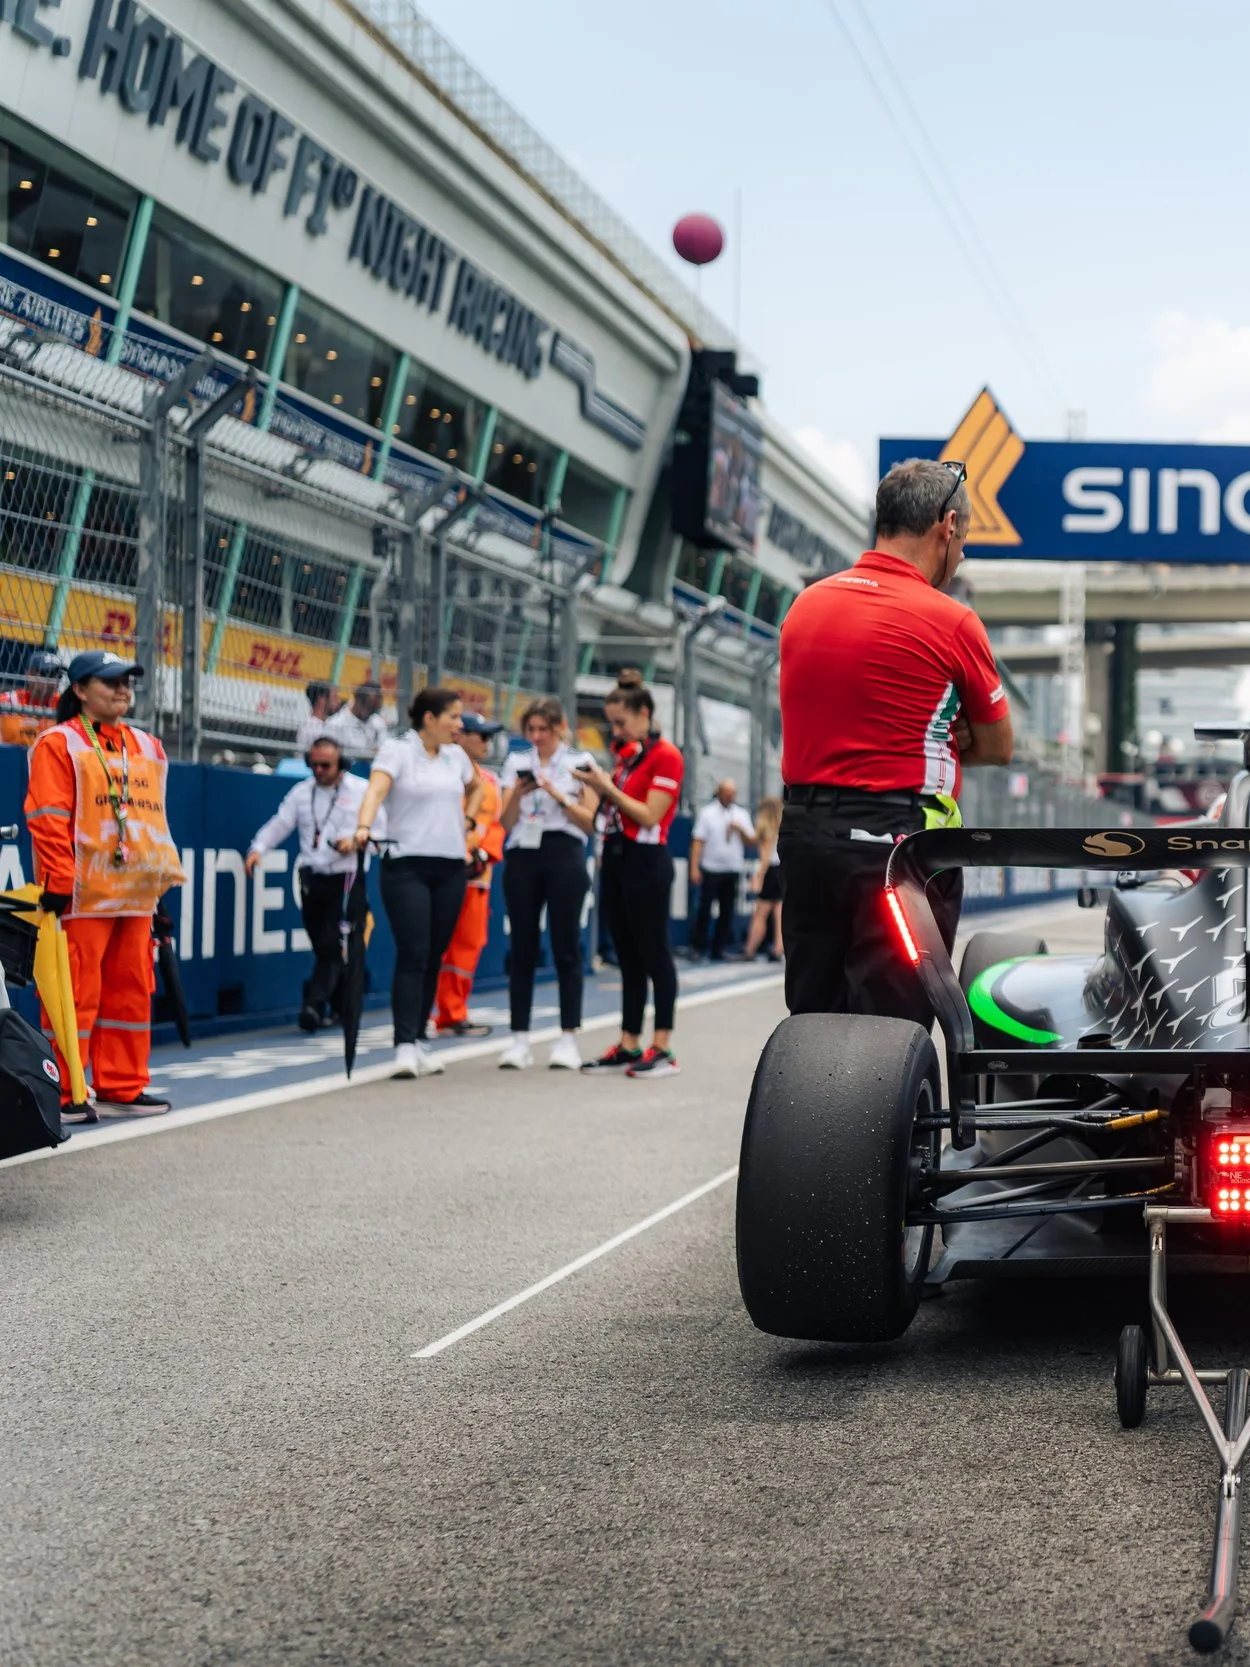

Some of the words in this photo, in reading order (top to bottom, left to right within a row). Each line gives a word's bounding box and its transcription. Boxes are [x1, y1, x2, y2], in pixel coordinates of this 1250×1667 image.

[77, 0, 236, 163] HOME
[226, 94, 295, 196] OF
[348, 183, 459, 315] NIGHT
